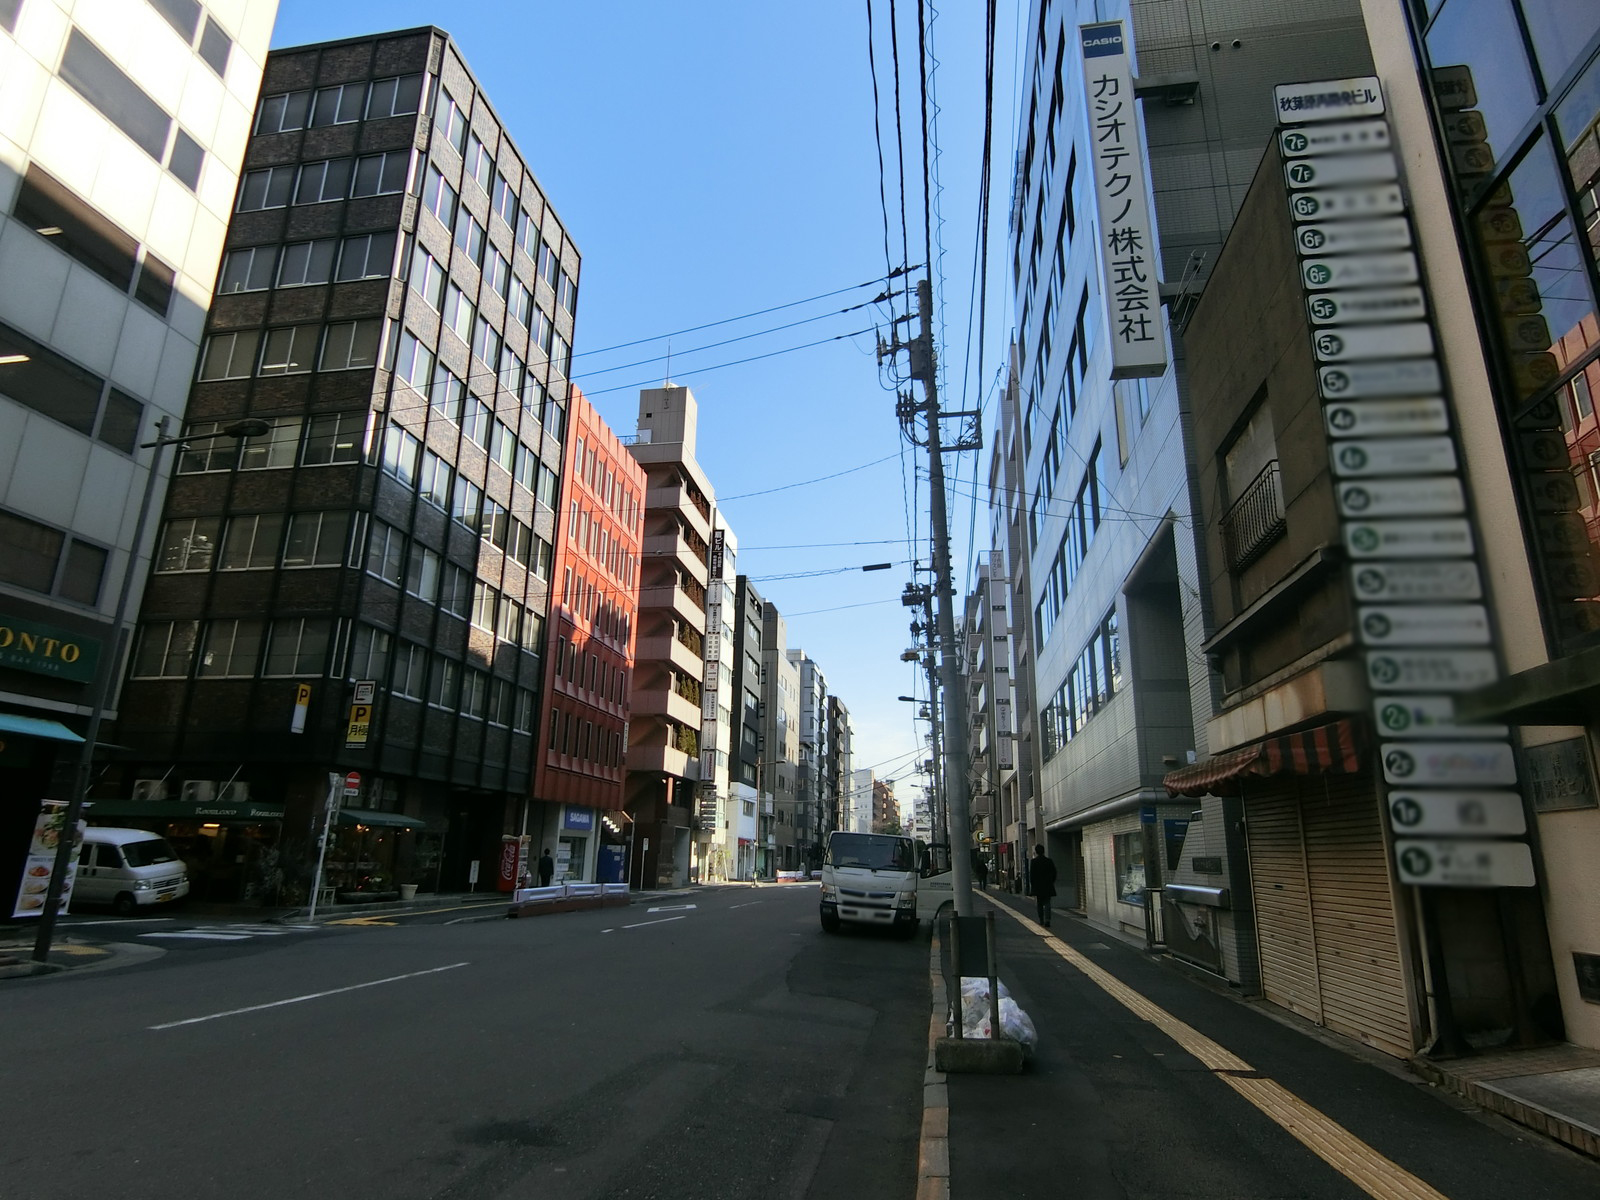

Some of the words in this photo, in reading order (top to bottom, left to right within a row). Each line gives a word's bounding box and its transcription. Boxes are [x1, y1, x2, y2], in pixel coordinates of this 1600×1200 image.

[1083, 36, 1122, 47] CASIO
[1286, 136, 1305, 150] 7F
[1293, 166, 1311, 182] 7F
[1093, 74, 1155, 344] カシオテクノ株式会社
[1297, 199, 1316, 214] 6F
[1303, 232, 1322, 247] 6F
[1310, 267, 1327, 282] 6F
[1313, 301, 1333, 317] 5F
[1320, 337, 1340, 353] 5F
[0, 626, 81, 664] ONTO
[299, 688, 308, 702] P
[355, 707, 367, 722] P
[348, 724, 369, 736] 月極
